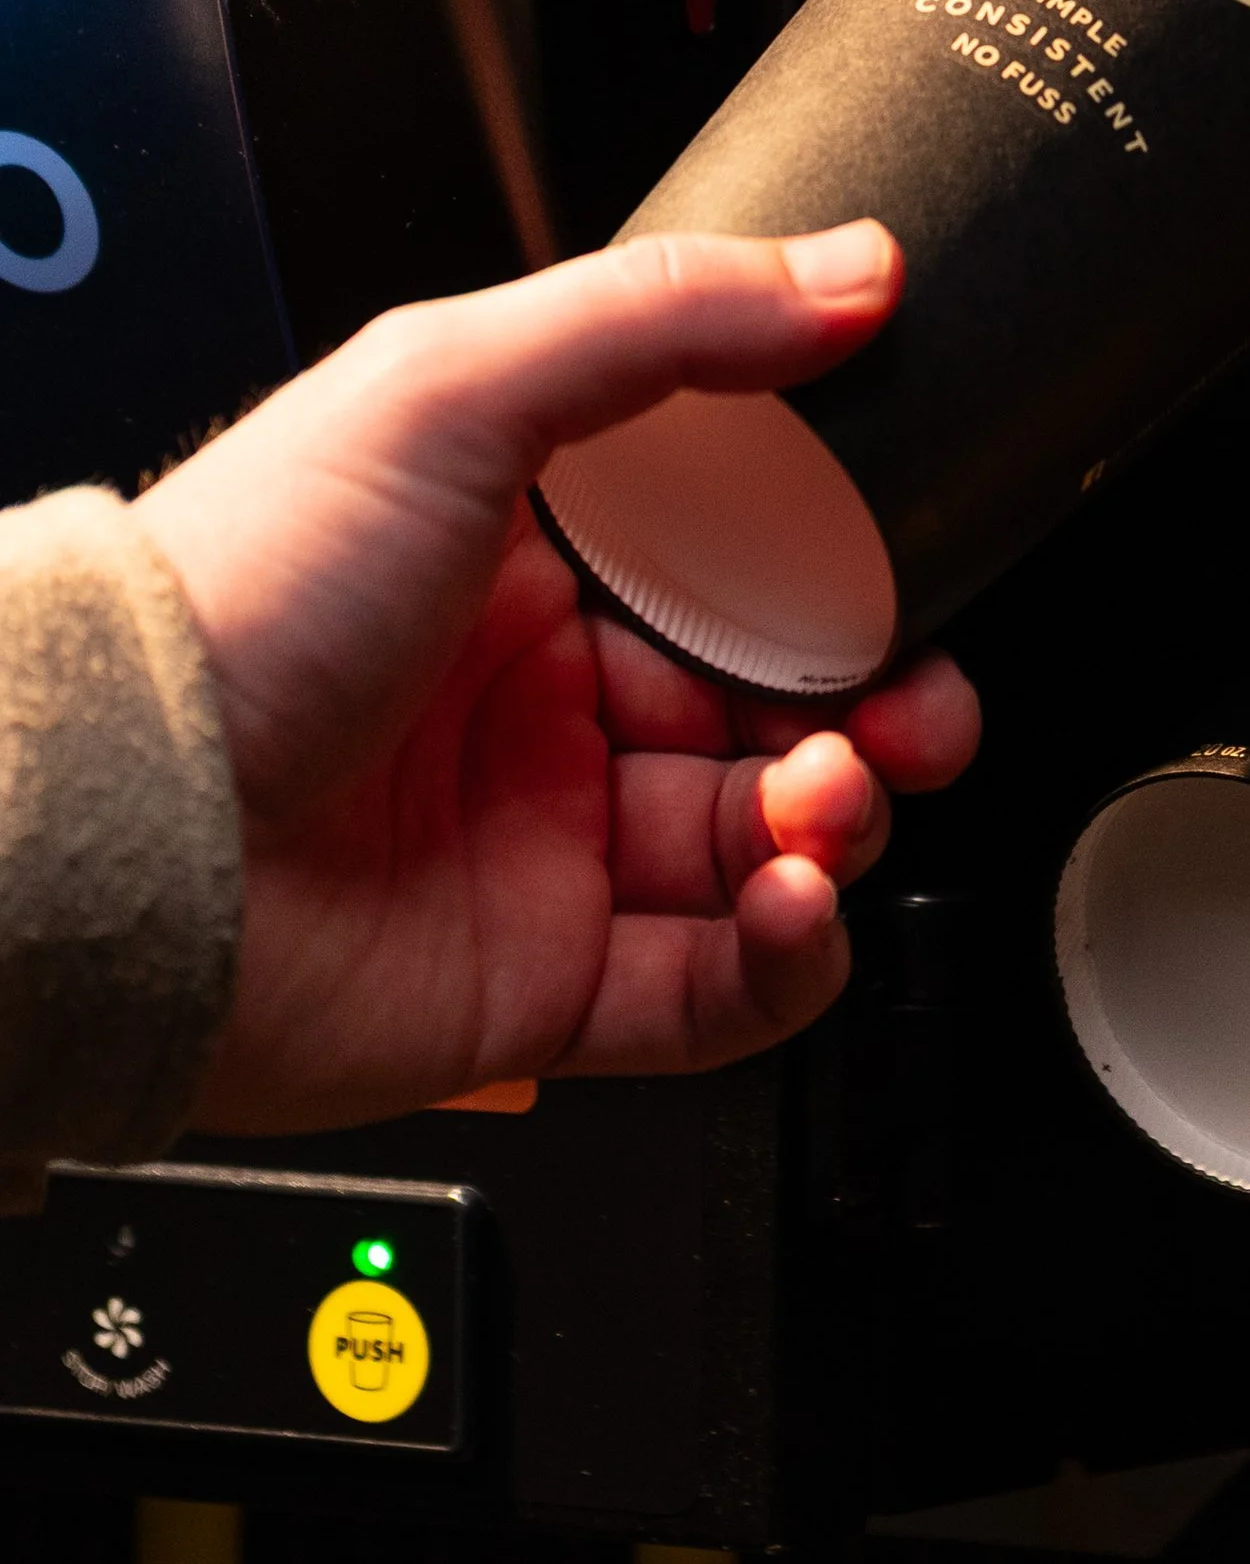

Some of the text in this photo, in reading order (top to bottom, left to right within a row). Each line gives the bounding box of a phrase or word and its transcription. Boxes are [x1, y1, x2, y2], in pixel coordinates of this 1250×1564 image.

[950, 32, 1077, 125] NO FUSS
[335, 1335, 404, 1363] PUSH
